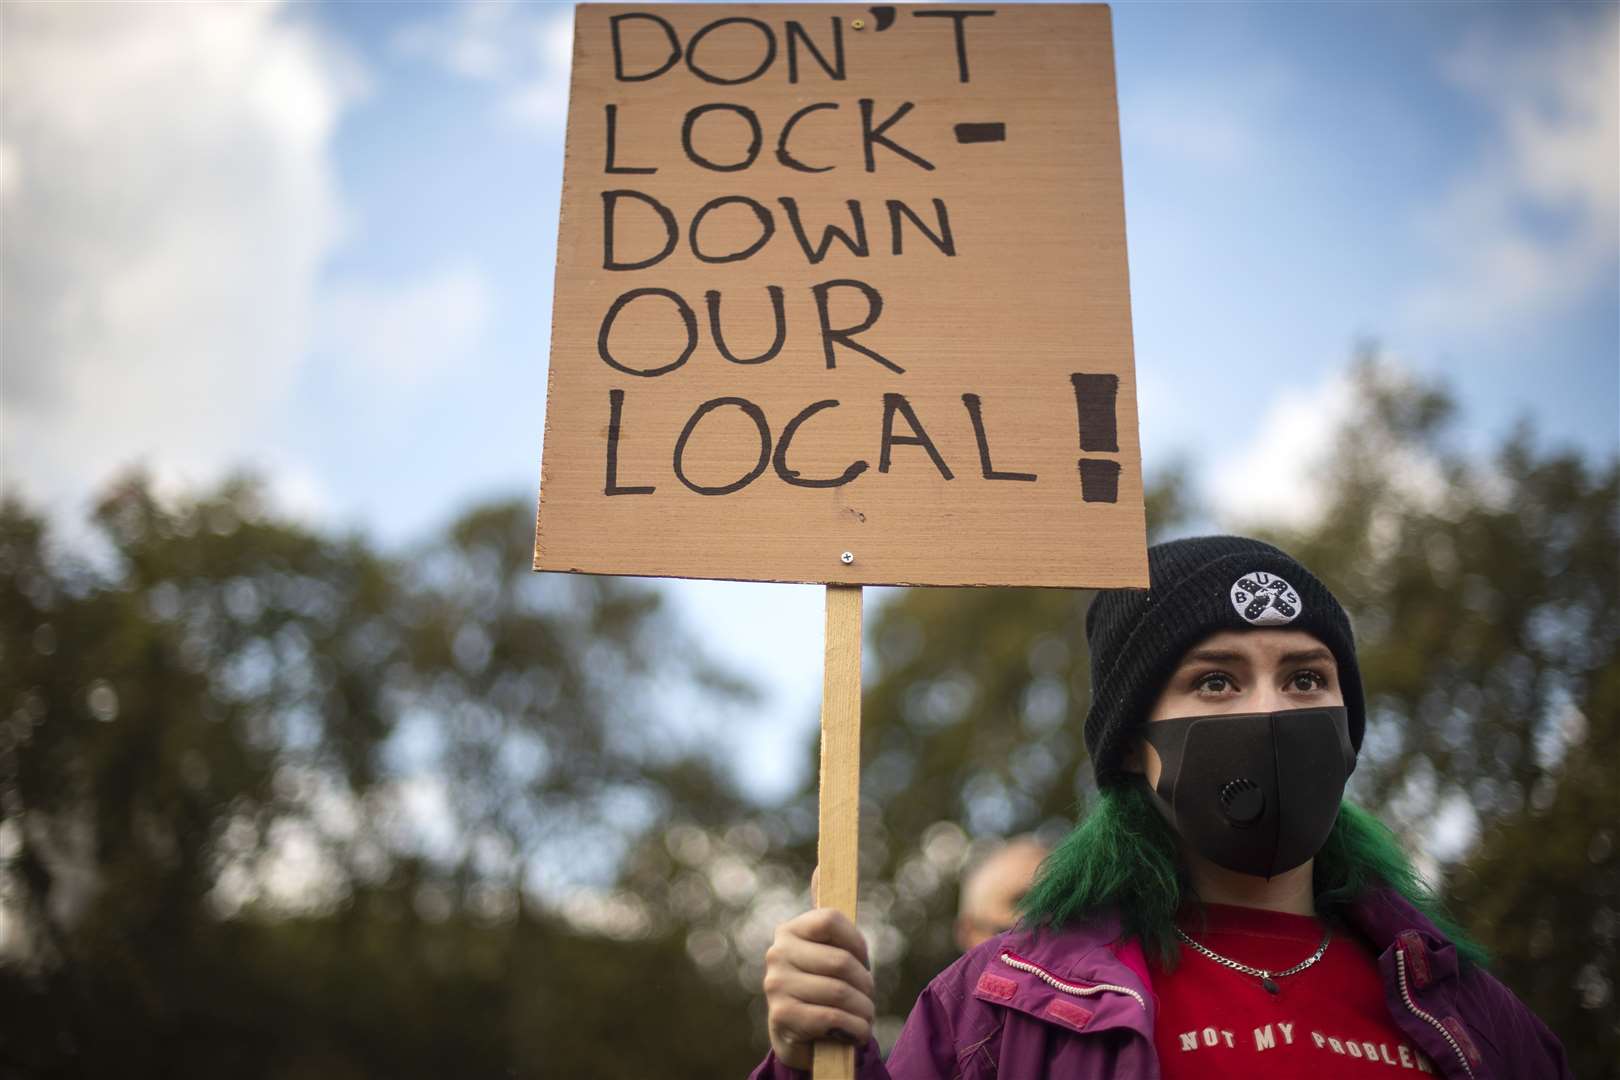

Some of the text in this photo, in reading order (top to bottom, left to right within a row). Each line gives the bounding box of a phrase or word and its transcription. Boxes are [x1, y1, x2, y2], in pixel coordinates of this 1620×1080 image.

[609, 6, 996, 86] DON'T
[604, 98, 1006, 174] LOCK-
[601, 189, 956, 271] DOWN
[597, 279, 905, 377] OUR
[1179, 1026, 1235, 1052] NOT
[1253, 1022, 1295, 1052] MY
